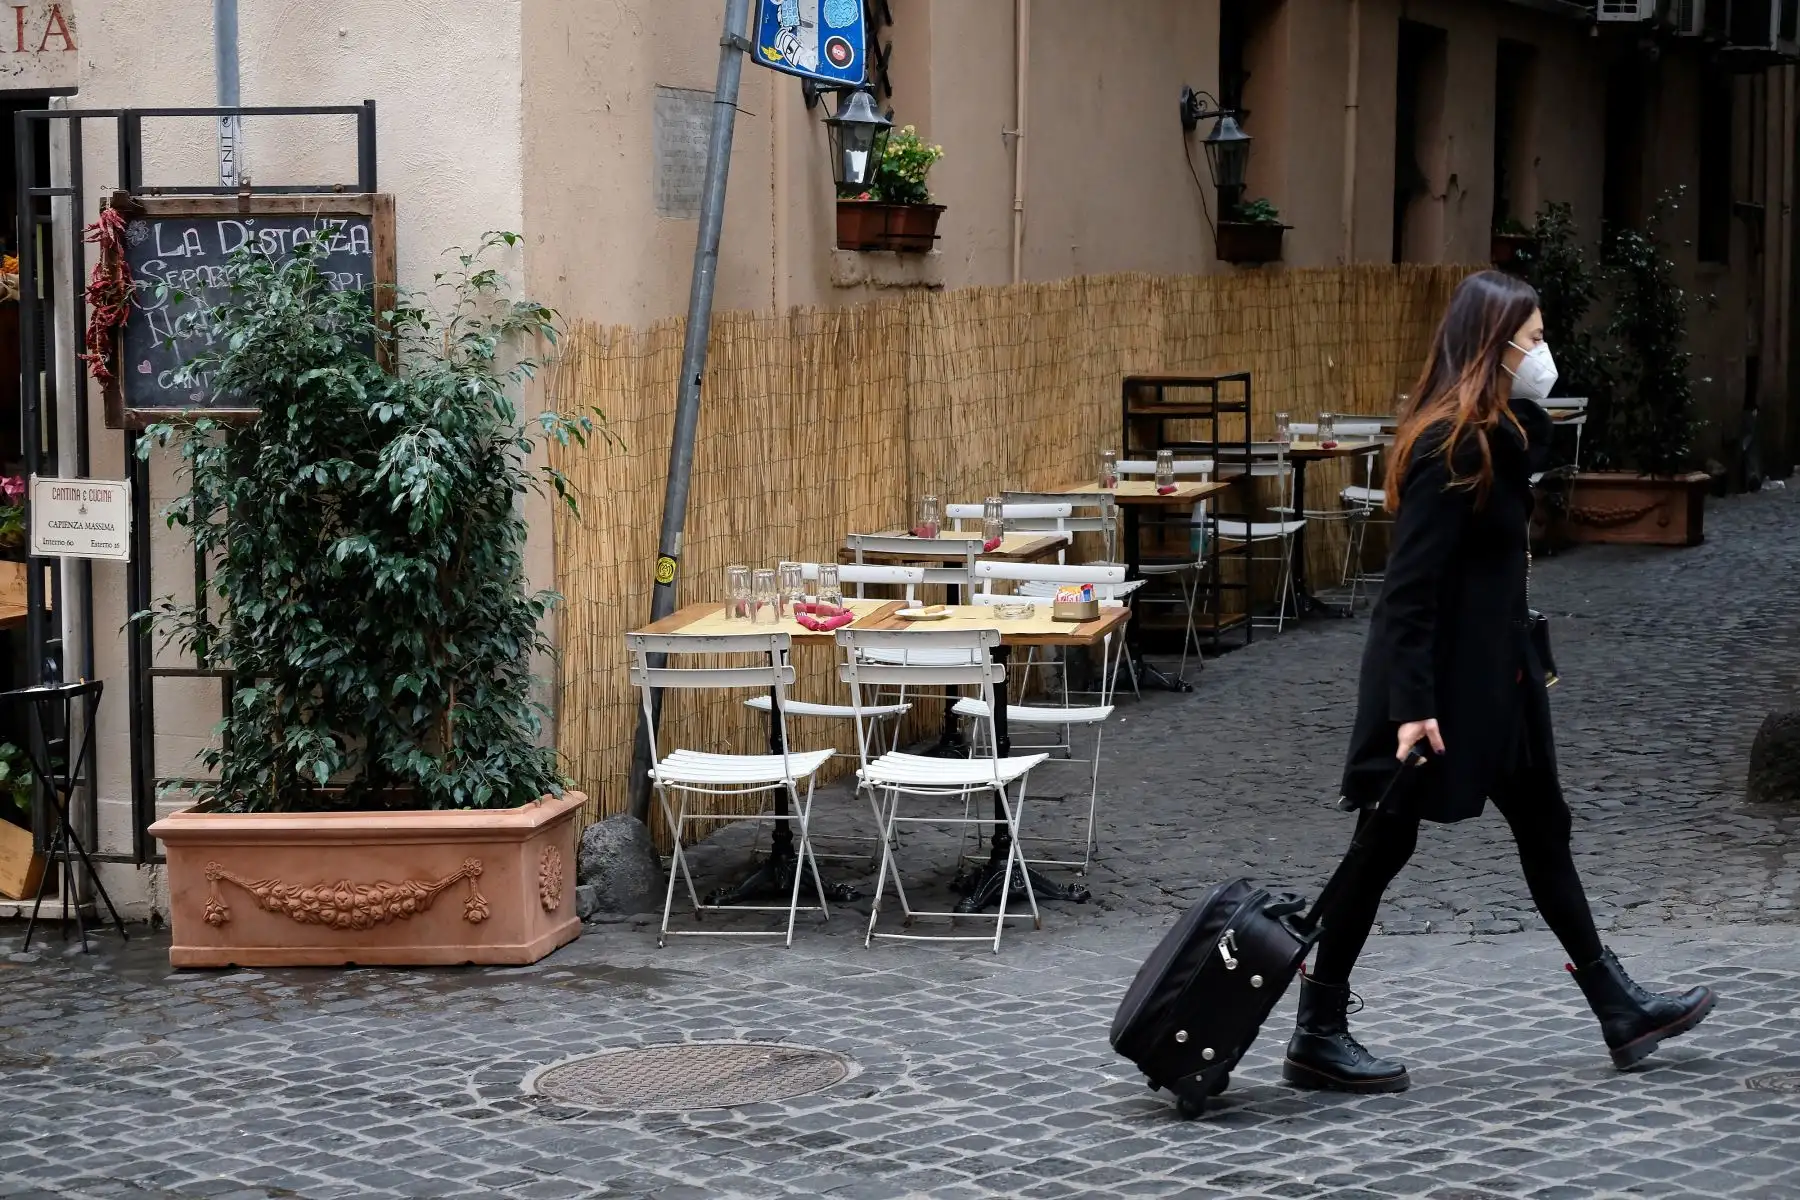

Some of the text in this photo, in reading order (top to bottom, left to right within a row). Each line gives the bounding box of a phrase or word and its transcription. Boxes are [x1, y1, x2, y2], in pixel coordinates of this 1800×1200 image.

[0, 4, 78, 53] IA
[52, 487, 80, 501] CANTINA
[89, 489, 112, 503] CUCINA
[48, 520, 115, 532] CAPIENZA MASSIMA
[42, 537, 66, 546] Interno
[90, 539, 113, 549] Esterno
